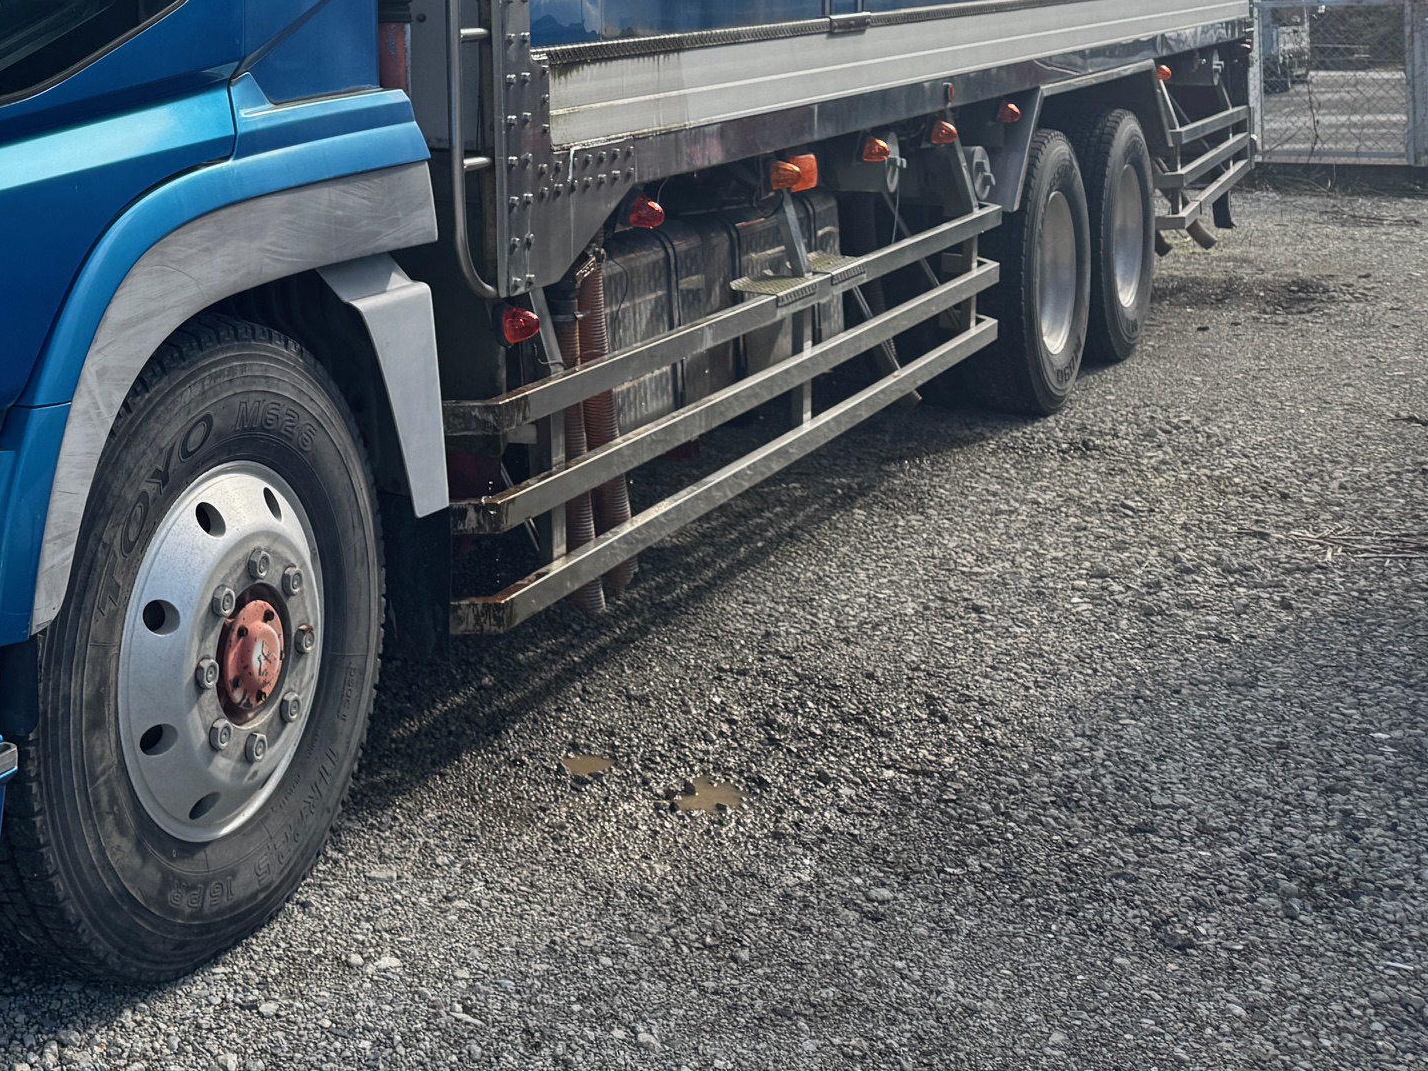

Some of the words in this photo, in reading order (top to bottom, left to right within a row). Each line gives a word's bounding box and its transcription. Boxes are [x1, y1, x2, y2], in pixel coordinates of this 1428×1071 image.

[96, 411, 213, 616] TOYO
[233, 397, 317, 452] M626
[169, 875, 234, 909] 16PR
